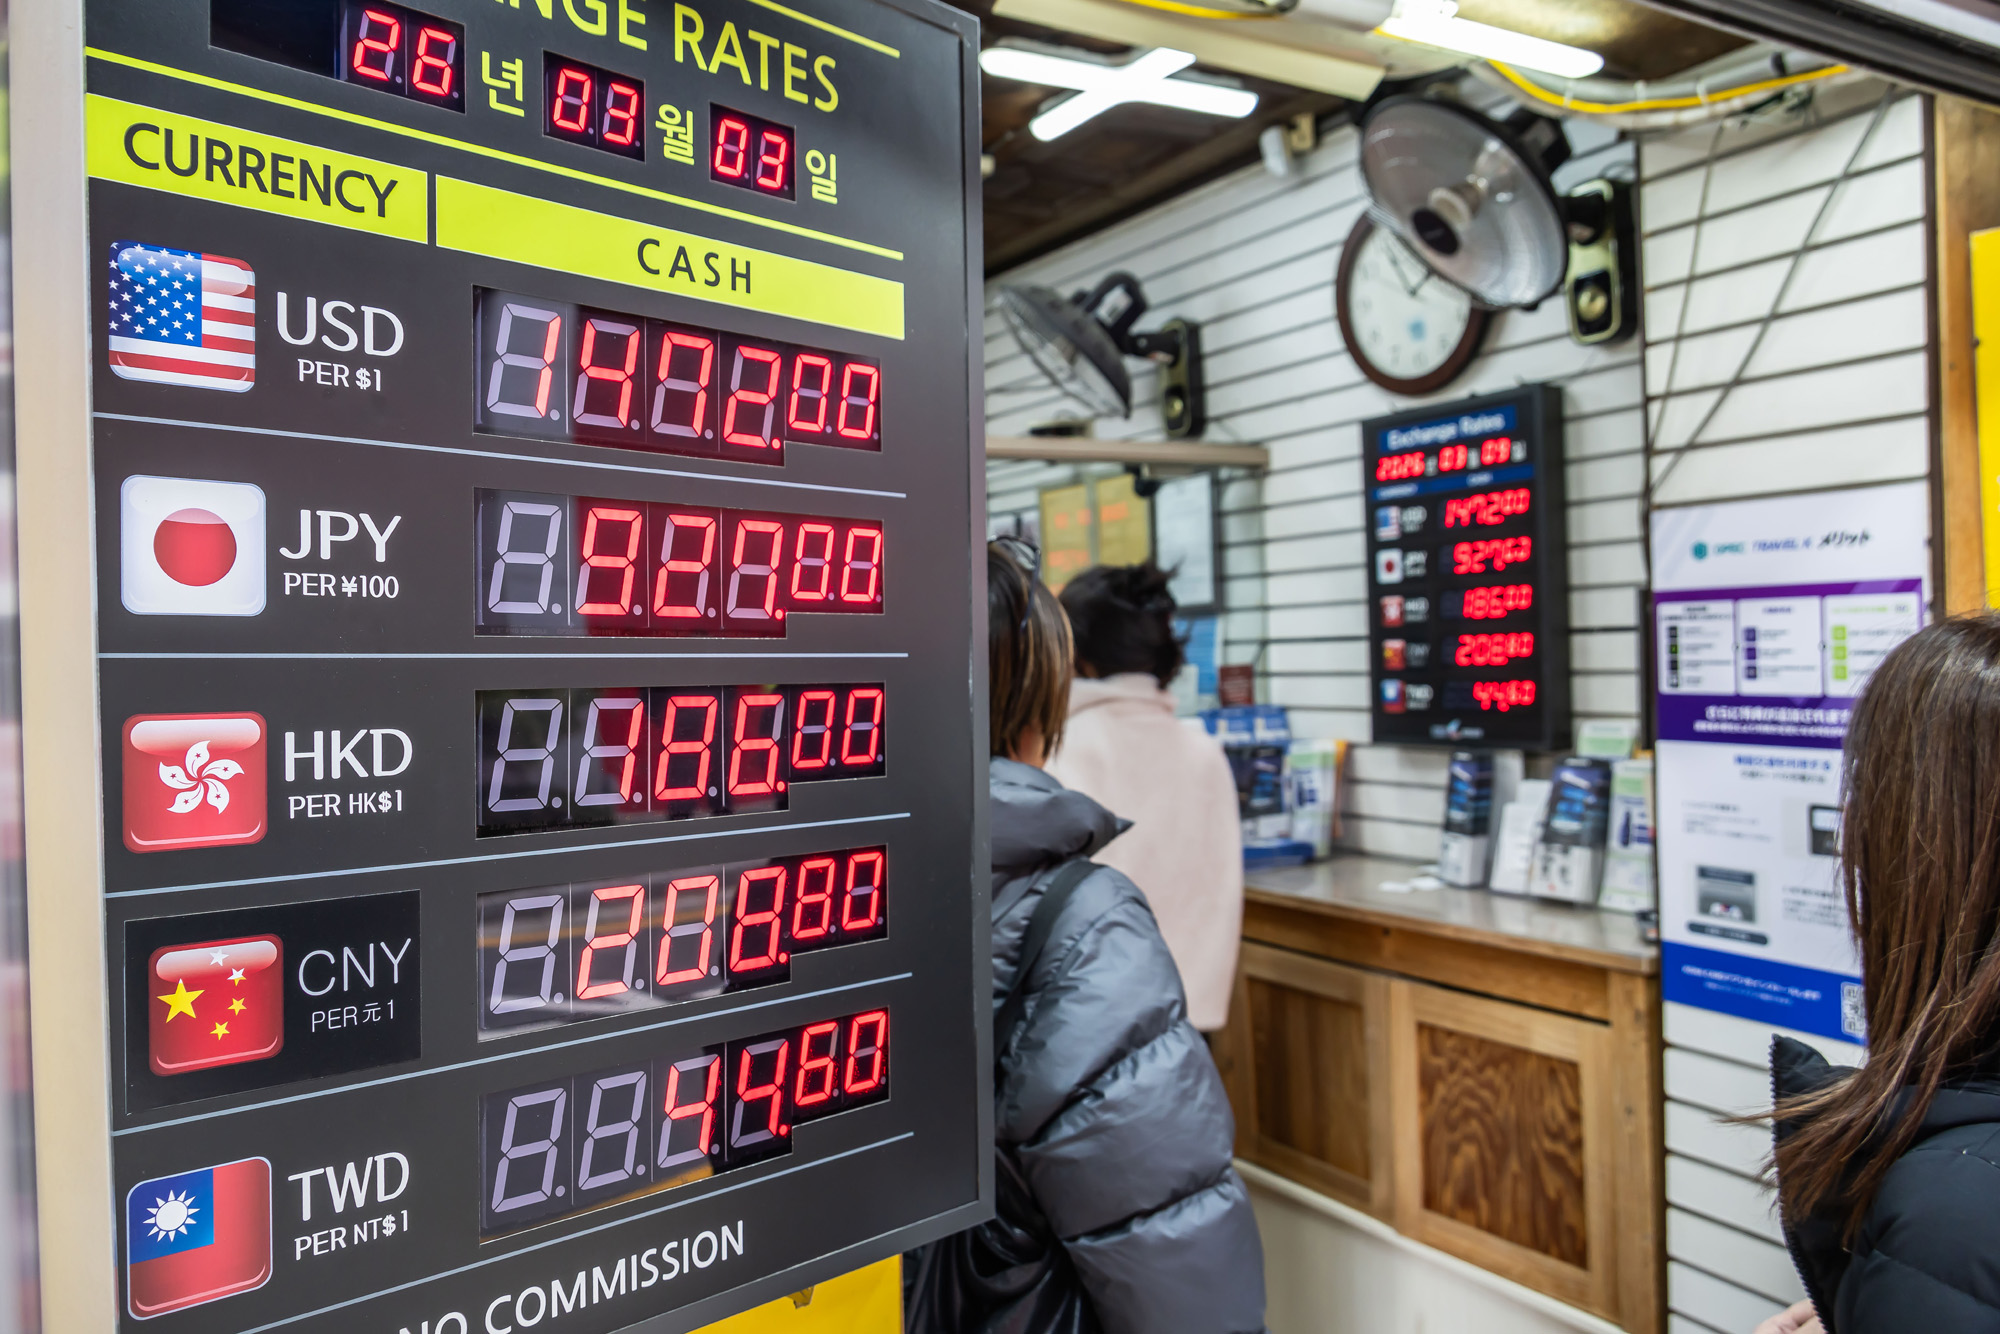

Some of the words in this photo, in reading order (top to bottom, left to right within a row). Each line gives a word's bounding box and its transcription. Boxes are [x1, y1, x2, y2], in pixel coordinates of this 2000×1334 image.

[674, 2, 839, 113] RATES
[352, 9, 457, 98] 26
[481, 51, 525, 118] 년
[552, 67, 640, 147] 03
[655, 103, 696, 166] 월
[714, 118, 789, 191] 03
[805, 149, 838, 205] 일
[123, 122, 399, 219] CURRENCY
[636, 238, 753, 295] CASH
[277, 290, 405, 358] USD
[297, 358, 350, 389] PER
[355, 366, 382, 393] $1
[1387, 424, 1458, 450] Exchange
[1459, 414, 1505, 436] Rates
[279, 508, 402, 563] JPY
[283, 572, 336, 597] PER
[341, 575, 400, 599] ¥100
[284, 728, 413, 782] HKD
[288, 794, 341, 819] PER
[348, 789, 403, 815] HK$1
[298, 937, 412, 997] CNY
[311, 1005, 358, 1033] PER
[287, 1151, 410, 1222] TWD
[294, 1226, 346, 1261] PER
[354, 1209, 410, 1246] NT$1
[484, 1219, 744, 1334] COMMISSION
